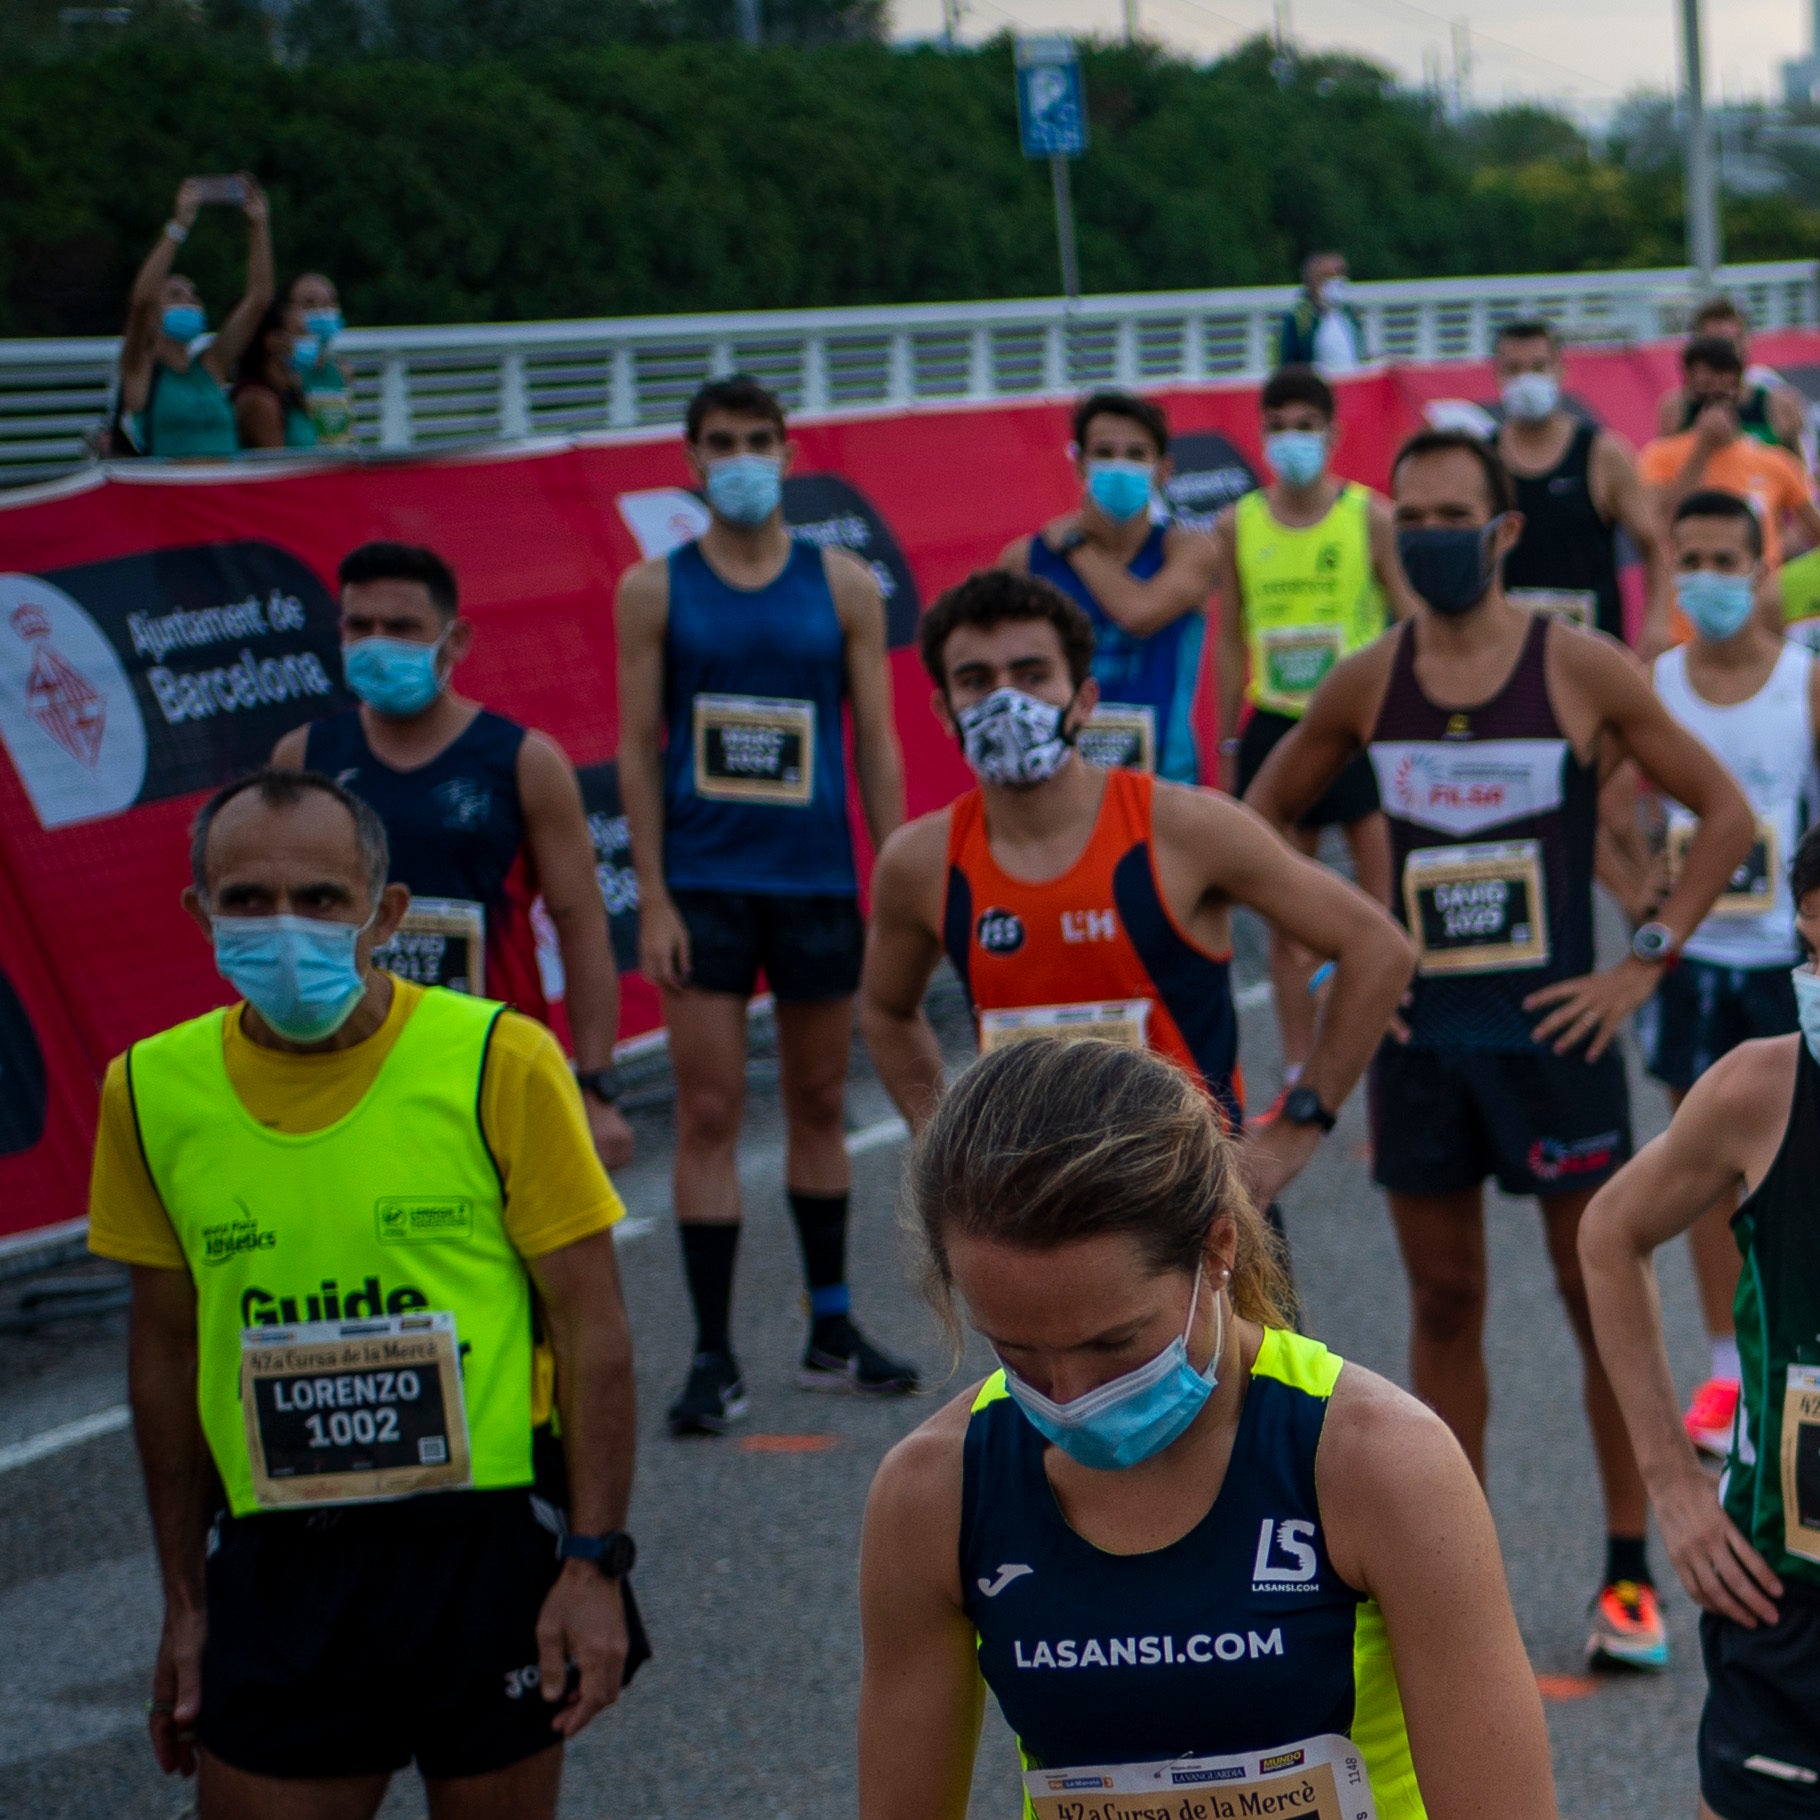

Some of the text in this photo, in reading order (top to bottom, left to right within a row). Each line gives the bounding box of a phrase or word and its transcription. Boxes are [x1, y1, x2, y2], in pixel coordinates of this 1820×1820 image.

[127, 587, 306, 661] Ajuntament de
[146, 648, 333, 725] Barcelona
[241, 1275, 430, 1328] Guide
[274, 1369, 421, 1413] LORENZO
[305, 1406, 400, 1449] 1002
[1252, 1583, 1320, 1592] LASANSI.COM
[1014, 1628, 1285, 1668] LASANSI.COM
[1345, 1757, 1361, 1785] 1148
[1213, 1796, 1236, 1818] la
[1239, 1780, 1316, 1817] Mercè
